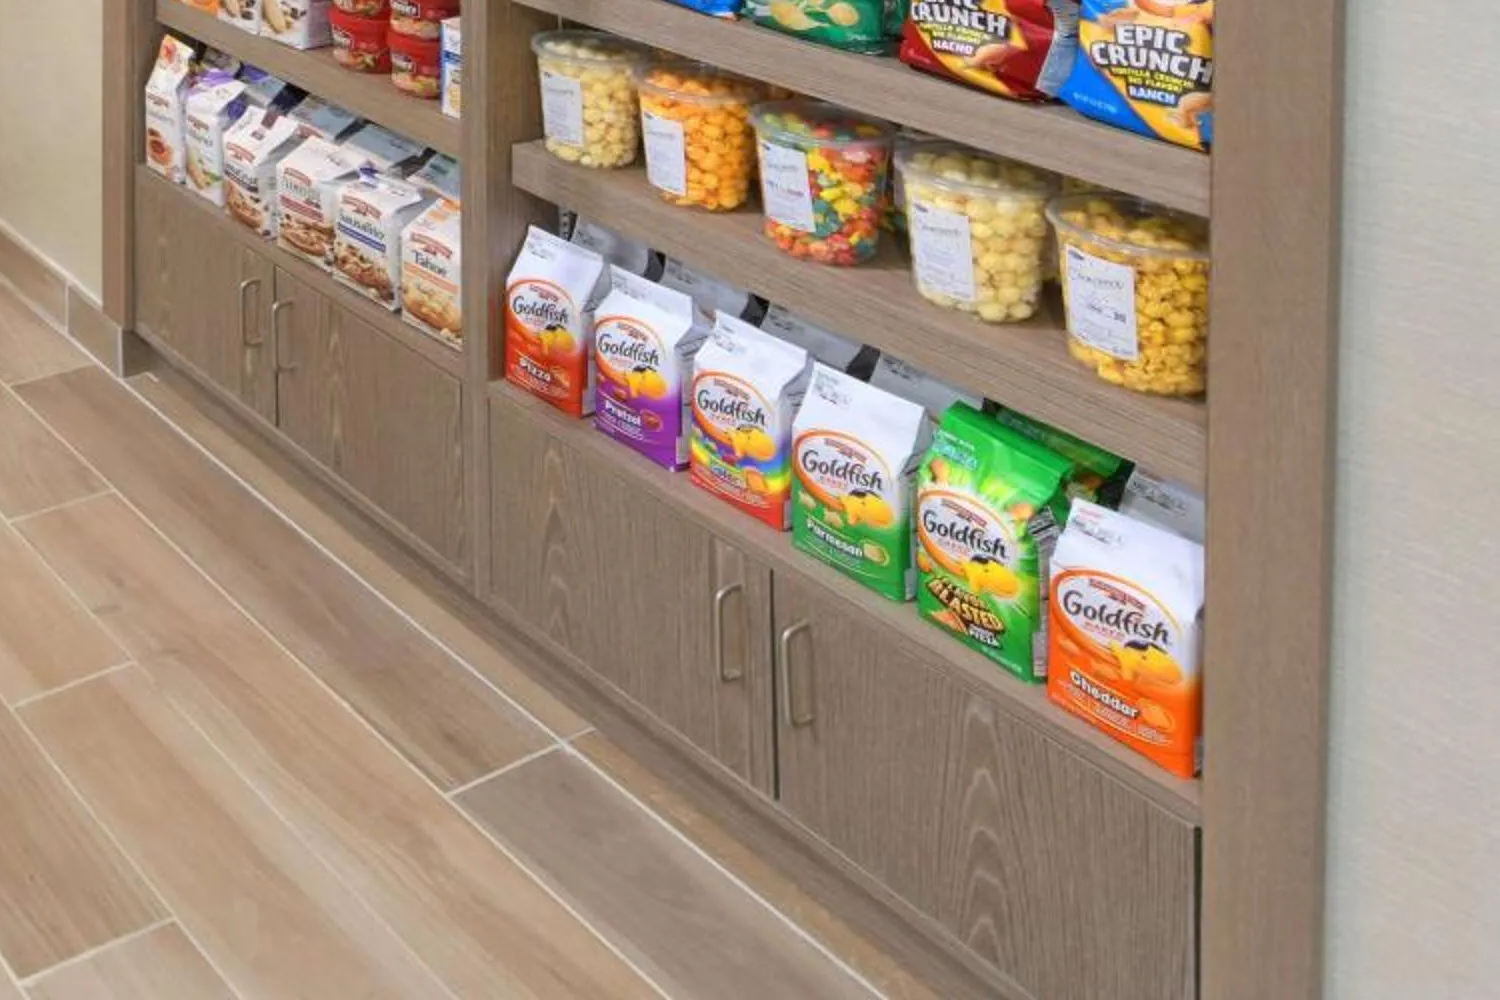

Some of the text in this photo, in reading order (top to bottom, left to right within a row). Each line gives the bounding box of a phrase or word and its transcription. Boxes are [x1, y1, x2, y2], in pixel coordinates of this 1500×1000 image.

[911, 1, 1008, 37] CRUNCH
[1116, 25, 1186, 54] EPIC
[1090, 43, 1213, 81] CRUNCH
[1128, 87, 1176, 105] RANCH
[512, 295, 569, 324] Goldfish
[598, 333, 660, 366] Goldfish
[697, 389, 766, 426] Goldfish
[801, 449, 884, 491] Goldfish
[922, 509, 1009, 560] Goldfish
[1063, 589, 1171, 644] Goldfish
[1069, 670, 1140, 719] Cheddar
